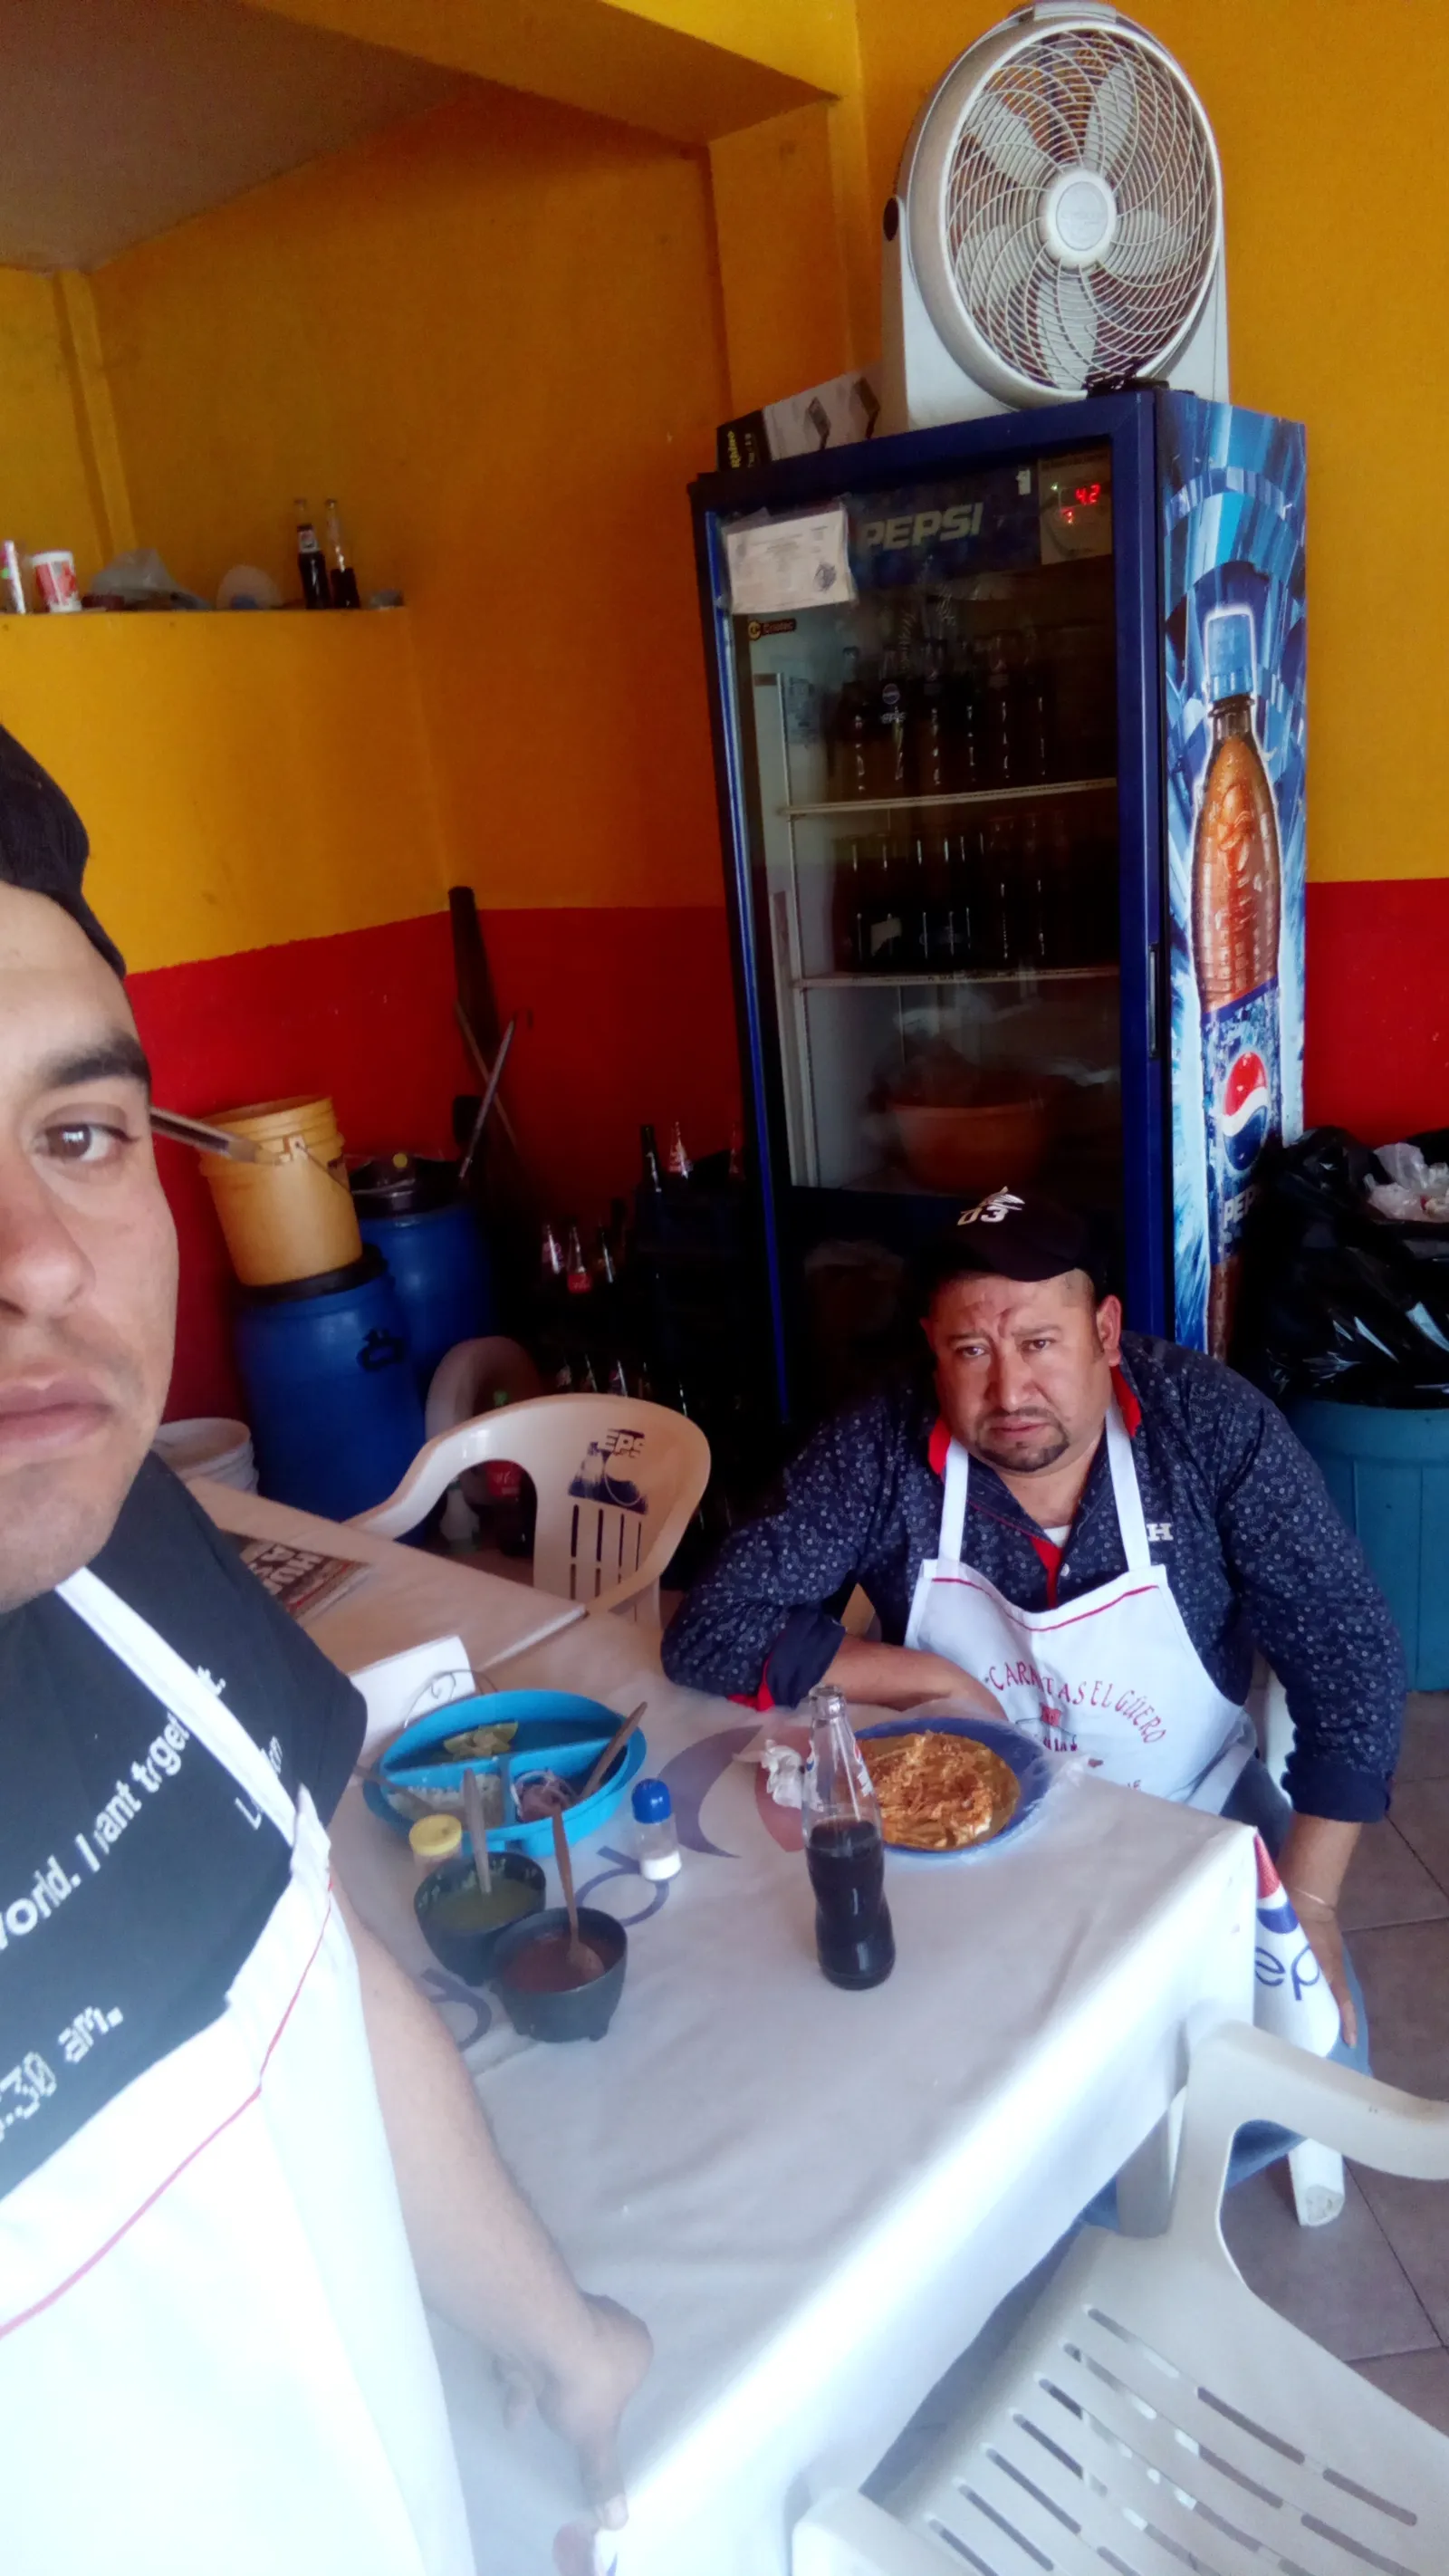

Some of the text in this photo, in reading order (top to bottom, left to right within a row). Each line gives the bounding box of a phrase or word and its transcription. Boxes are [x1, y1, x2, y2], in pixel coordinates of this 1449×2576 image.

[859, 502, 984, 551] PEPSI
[988, 1659, 1088, 1706] CARNTAS
[1089, 1680, 1115, 1709] EL
[0, 1854, 82, 1954] orld.
[92, 1779, 143, 1856] ant
[57, 2004, 124, 2066] am.
